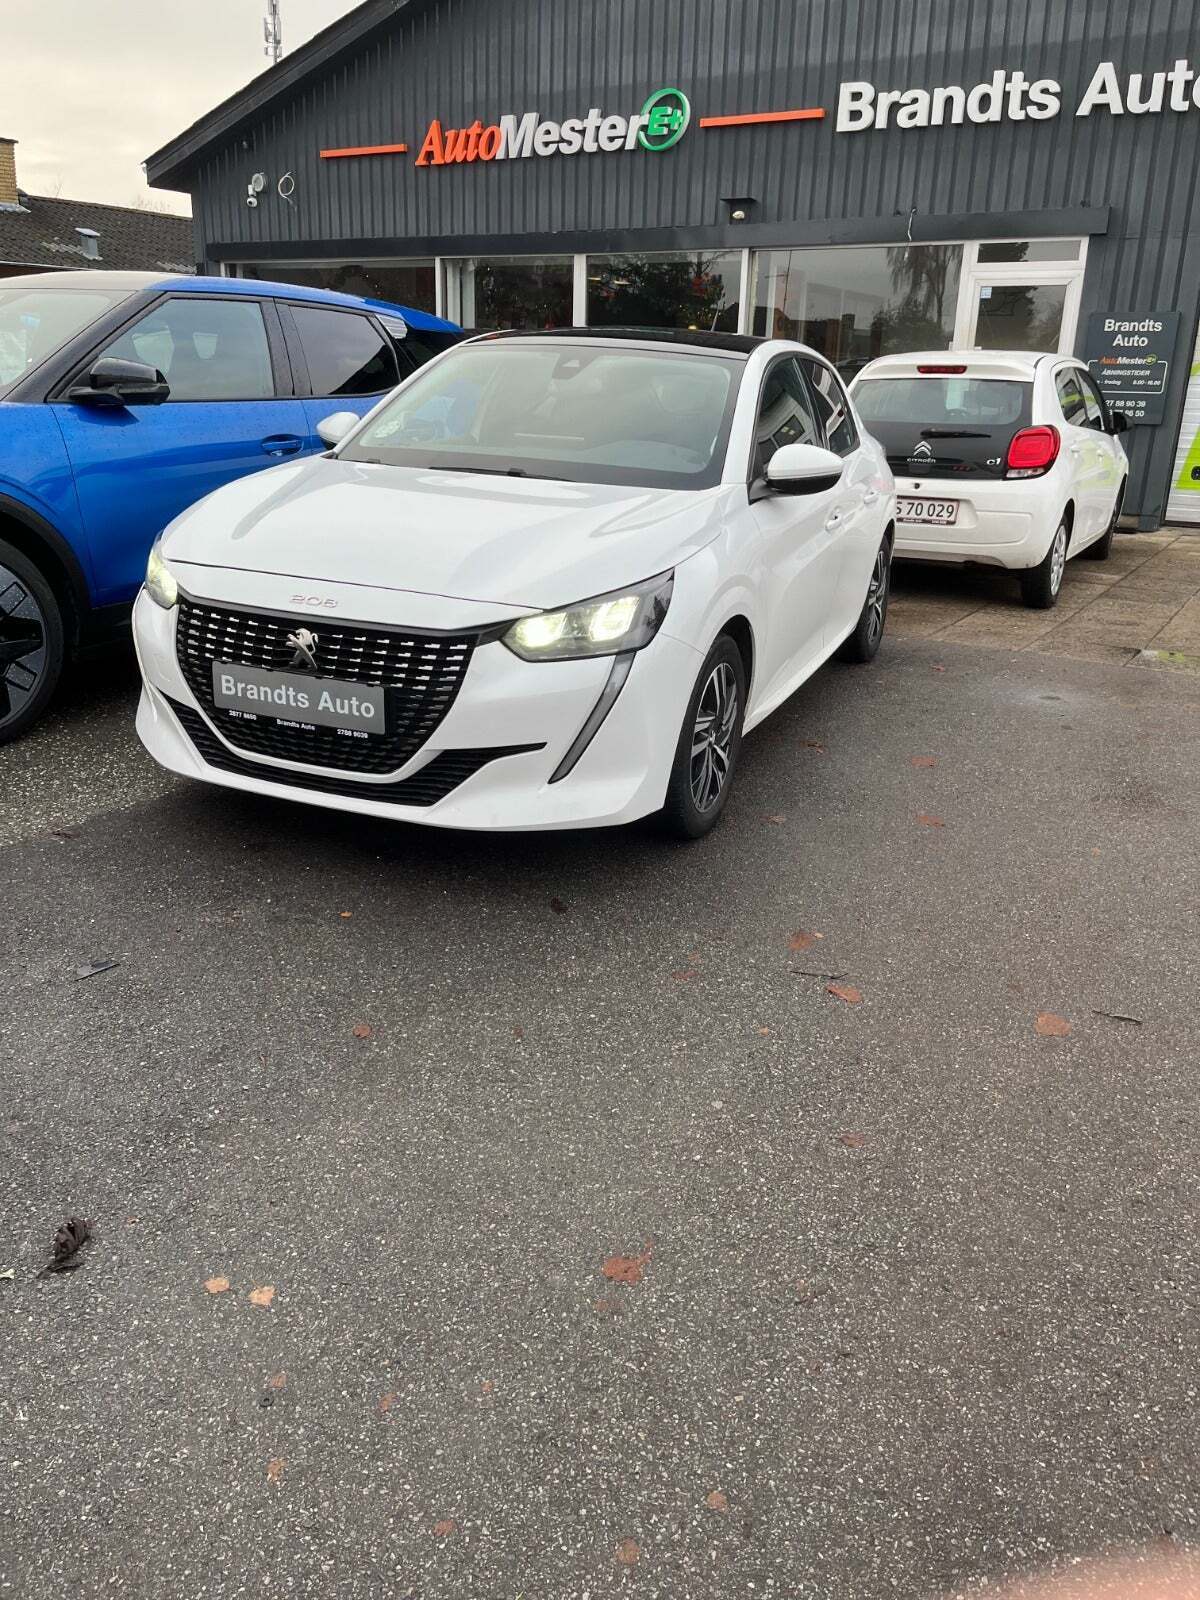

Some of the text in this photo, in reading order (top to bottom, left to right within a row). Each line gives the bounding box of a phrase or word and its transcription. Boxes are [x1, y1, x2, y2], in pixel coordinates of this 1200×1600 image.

[836, 59, 1200, 133] Brandts Aut
[415, 108, 650, 166] AutoMester
[1103, 318, 1163, 332] Brandts
[1112, 333, 1149, 347] Auto
[906, 502, 924, 517] 70
[927, 503, 955, 519] 029
[220, 674, 375, 719] Brandts Auto
